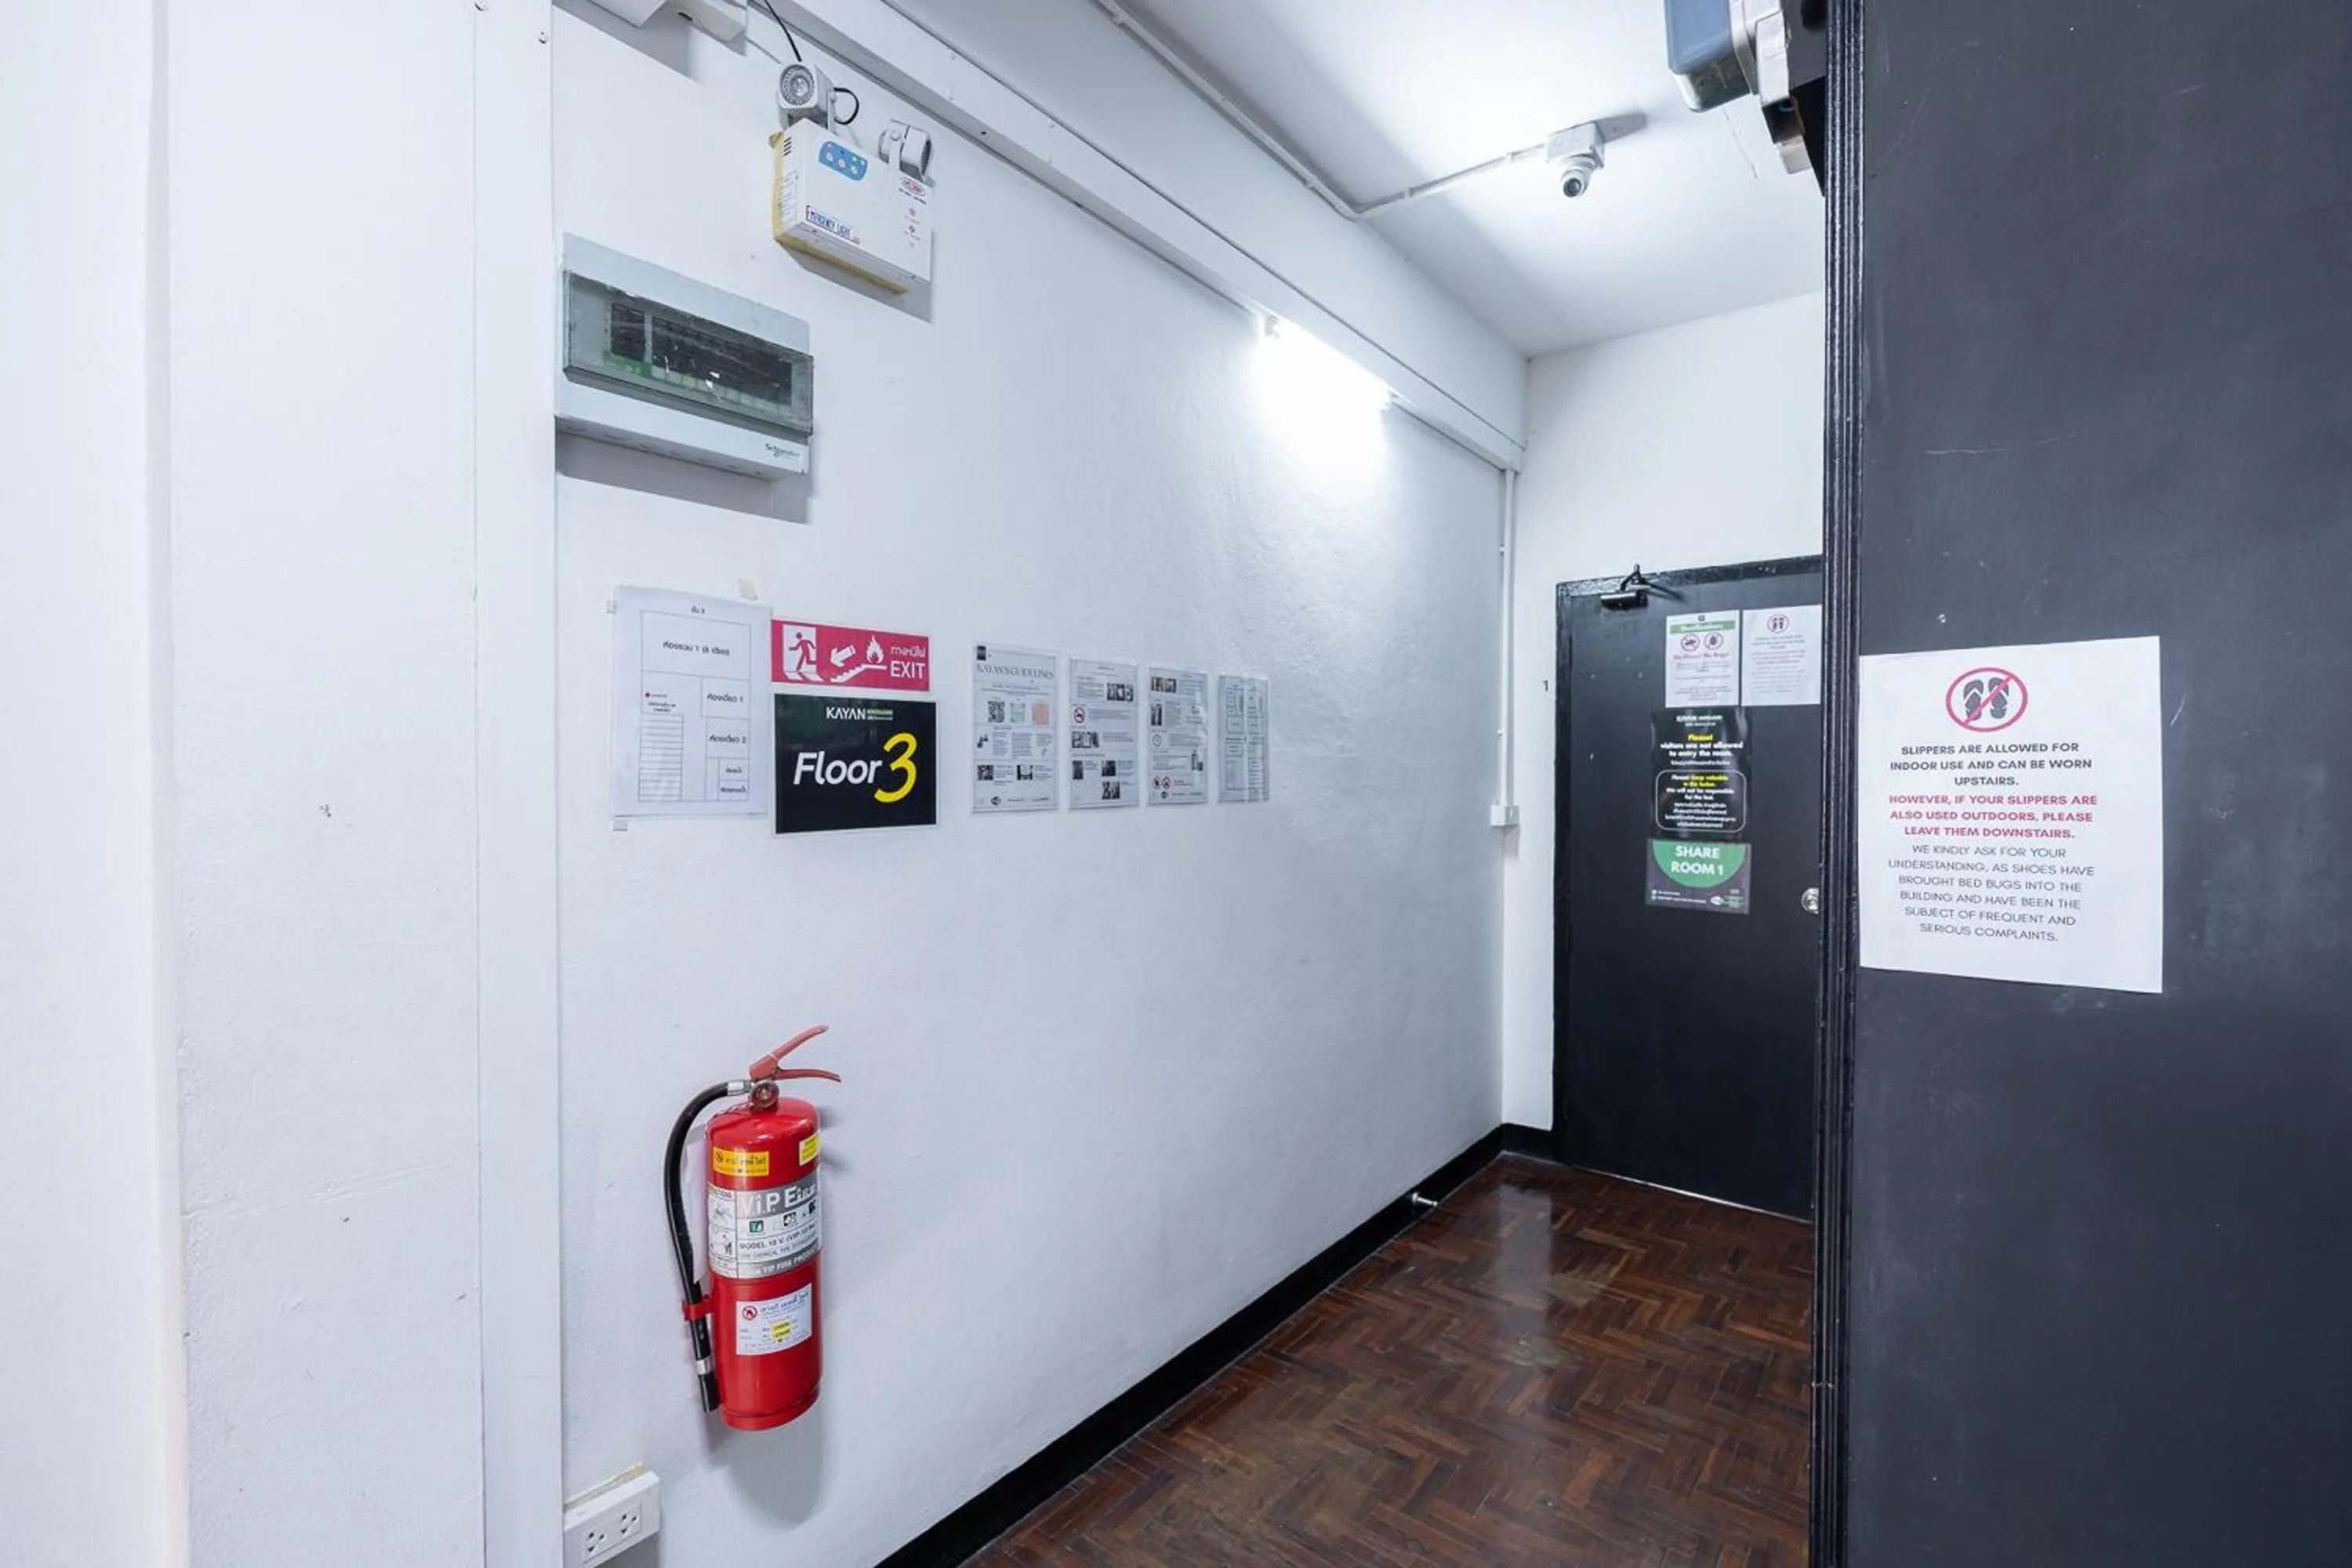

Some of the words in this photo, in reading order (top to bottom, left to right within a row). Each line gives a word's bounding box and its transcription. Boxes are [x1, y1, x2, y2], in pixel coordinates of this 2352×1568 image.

[891, 660, 926, 680] EXIT
[826, 706, 866, 720] KAYAN
[1713, 740, 1744, 749] allowed
[1901, 746, 1955, 755] SLIPPERS
[1958, 745, 1983, 754] ARE
[1985, 743, 2048, 753] ALLOWED
[2052, 742, 2079, 752] FOR
[793, 750, 883, 786] Floor
[873, 731, 917, 804] 3
[1890, 761, 1937, 771] INDOOR
[1940, 761, 1963, 771] USE
[1967, 760, 1994, 769] AND
[1998, 760, 2027, 769] CAN
[2030, 760, 2045, 769] BE
[2049, 759, 2092, 768] WORN
[1955, 776, 2020, 786] UPSTAIRS.
[1889, 795, 1951, 805] HOWEVER,
[1955, 795, 1965, 804] IF
[1969, 795, 2004, 804] YOUR
[2007, 795, 2068, 804] SLIPPERS
[2071, 796, 2097, 804] ARE
[1889, 811, 1922, 819] ALSO
[1926, 811, 1958, 820] USED
[2042, 812, 2092, 822] PLEASE
[1904, 826, 1940, 835] LEAVE
[1944, 827, 1980, 837] THEM
[1983, 828, 2075, 838] DOWNSTAIRS.
[1675, 845, 1720, 858] SHARE
[1912, 844, 1929, 854] WE
[1933, 846, 1970, 855] KINDLY
[1973, 847, 1997, 855] ASK
[2000, 848, 2027, 856] FOR
[2030, 848, 2067, 858] YOUR
[1671, 861, 1715, 875] ROOM
[1718, 864, 1723, 876] 1
[1889, 860, 1987, 872] UNDERSTANDING,
[1992, 863, 2009, 872] AS
[2013, 864, 2057, 875] SHOES
[2060, 866, 2095, 876] HAVE
[1898, 876, 1955, 886] BROUGHT
[1958, 878, 1983, 887] BED
[1986, 880, 2022, 889] BUGS
[2025, 881, 2056, 891] INTO
[2060, 883, 2082, 892] THE
[1900, 891, 1953, 902] BUILDING
[1956, 895, 1982, 903] AND
[1985, 896, 2016, 906] HAVE
[2021, 898, 2053, 908] BEEN
[2058, 899, 2081, 909] THE
[1904, 906, 1955, 917] SUBJECT
[1958, 910, 1976, 920] OF
[1980, 912, 2044, 924] FREQUENT
[2047, 916, 2077, 925] AND
[1919, 924, 1972, 935] SERIOUS
[1975, 927, 2058, 941] COMPLAINTS.
